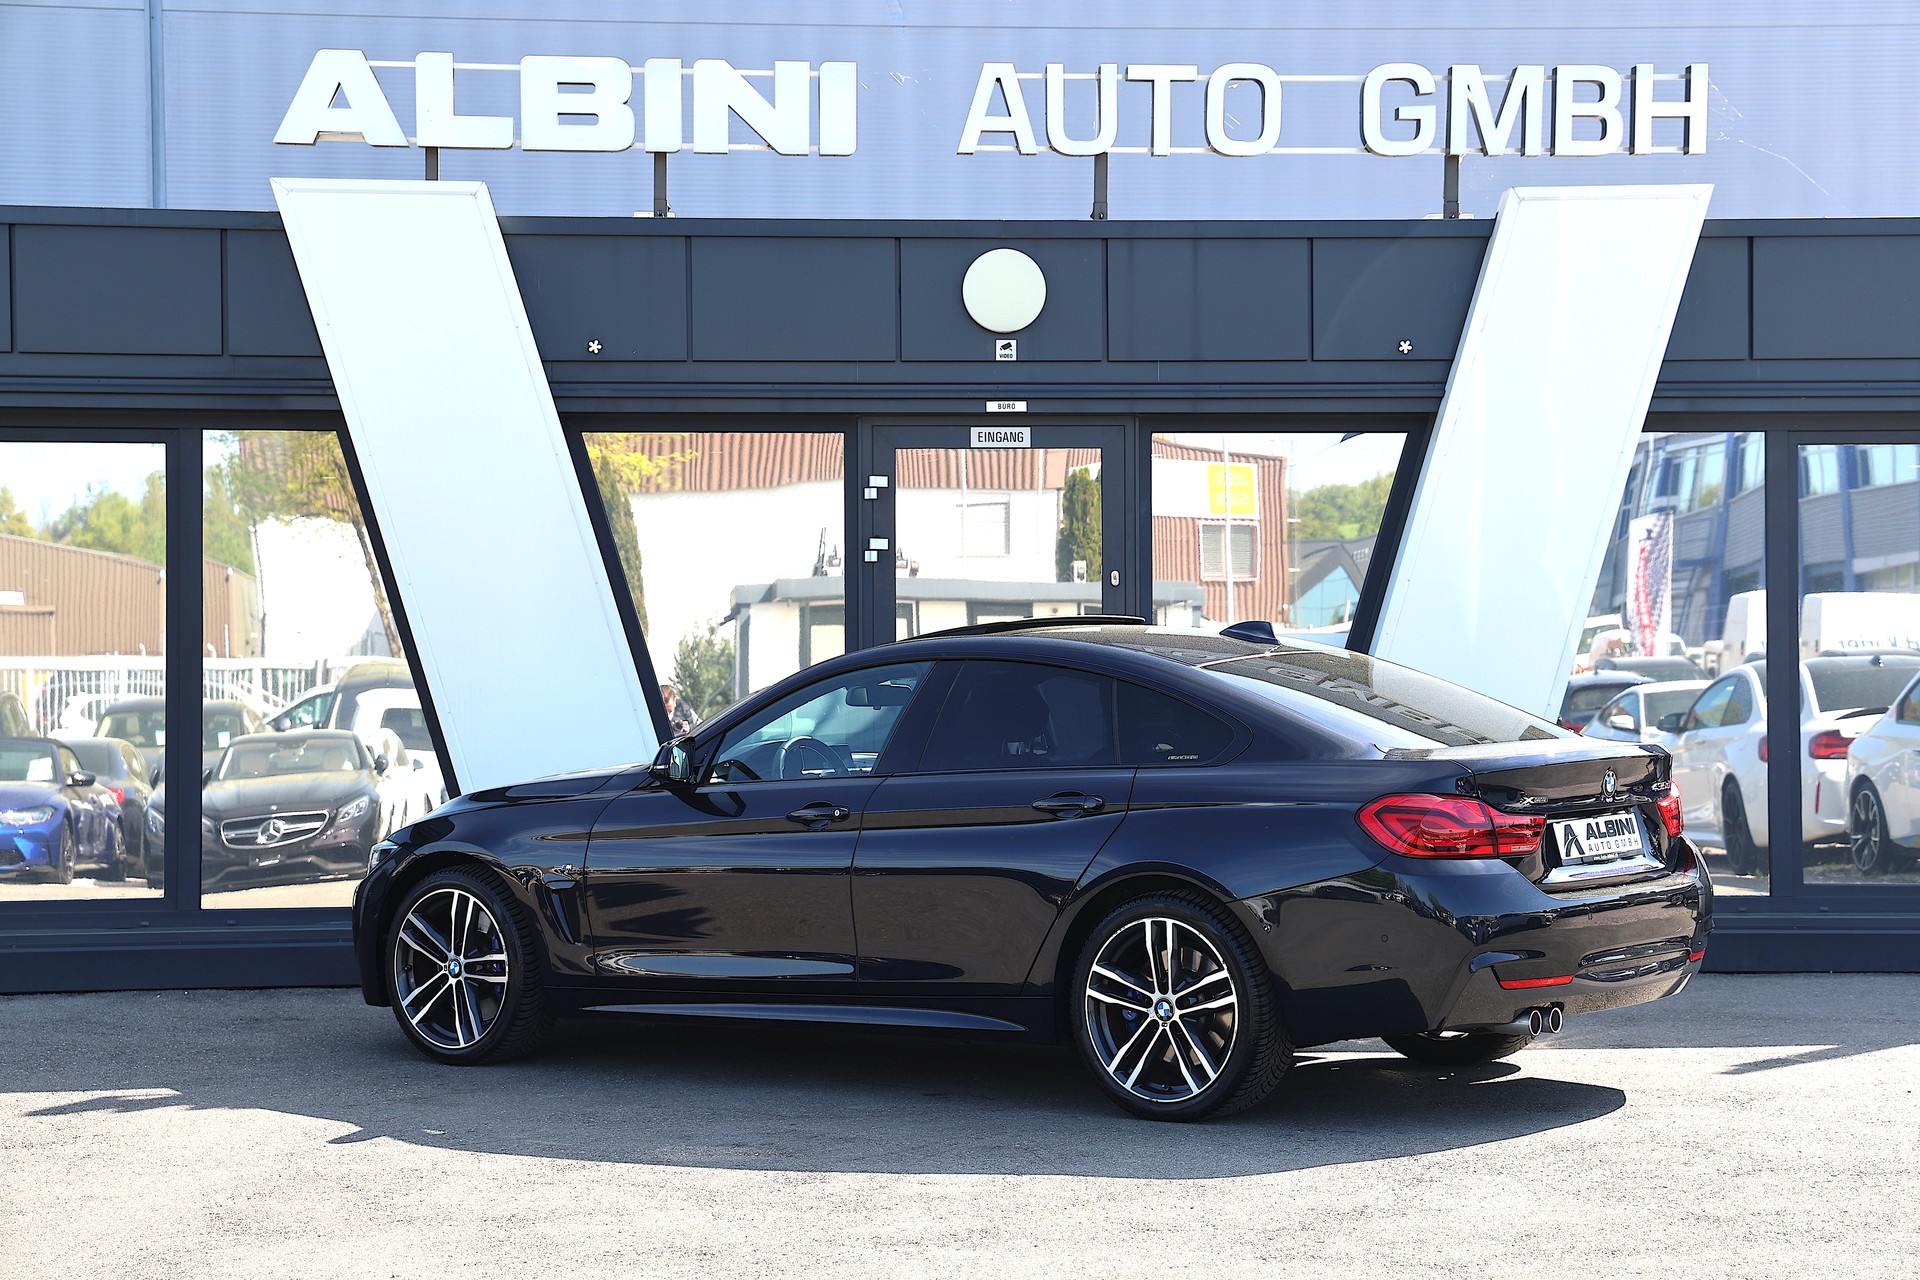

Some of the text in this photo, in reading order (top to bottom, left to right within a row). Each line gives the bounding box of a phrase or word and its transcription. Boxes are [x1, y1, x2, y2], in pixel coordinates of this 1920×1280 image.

[273, 49, 1709, 157] ALBINI AUTO GMBH
[997, 402, 1016, 410] BÜRO
[977, 431, 1024, 443] EINGANG
[1586, 817, 1636, 840] ALBINI
[1588, 837, 1639, 853] AUTO GMBH
